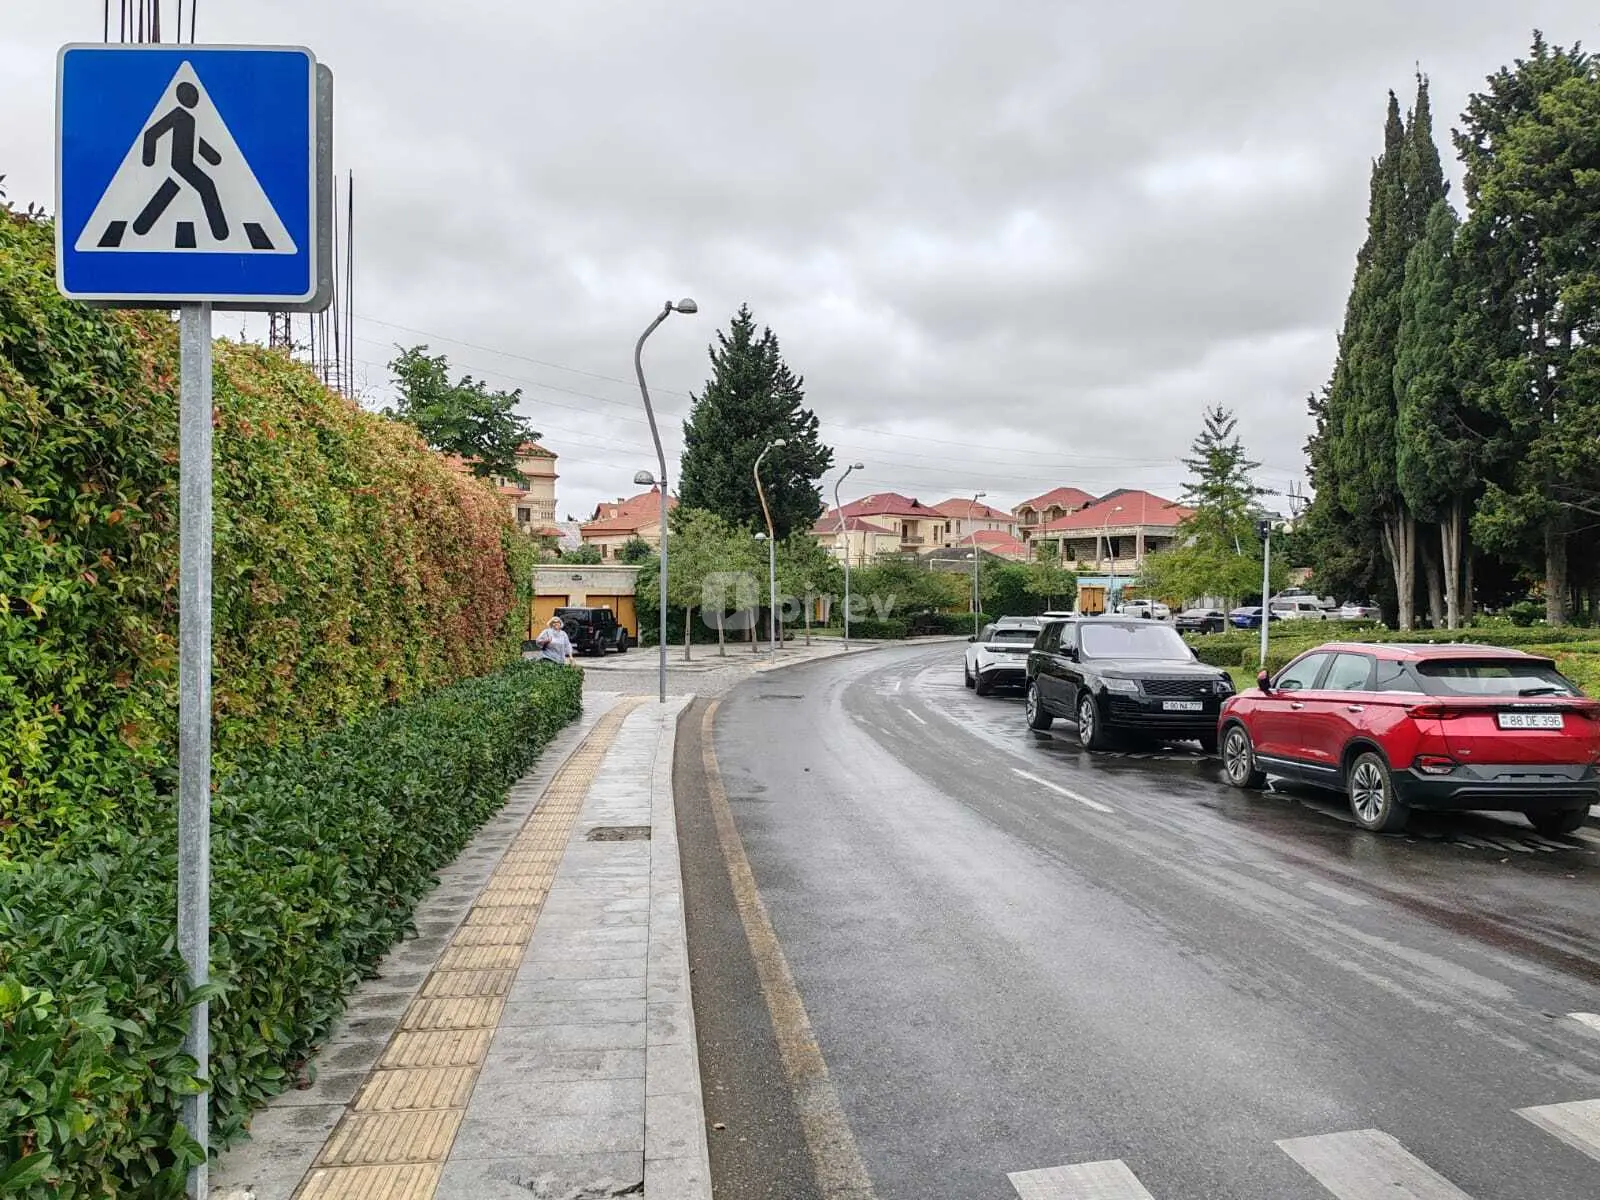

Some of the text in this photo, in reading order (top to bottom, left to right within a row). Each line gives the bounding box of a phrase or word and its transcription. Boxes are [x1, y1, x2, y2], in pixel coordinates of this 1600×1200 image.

[1509, 715, 1561, 726] 88 DE 396
